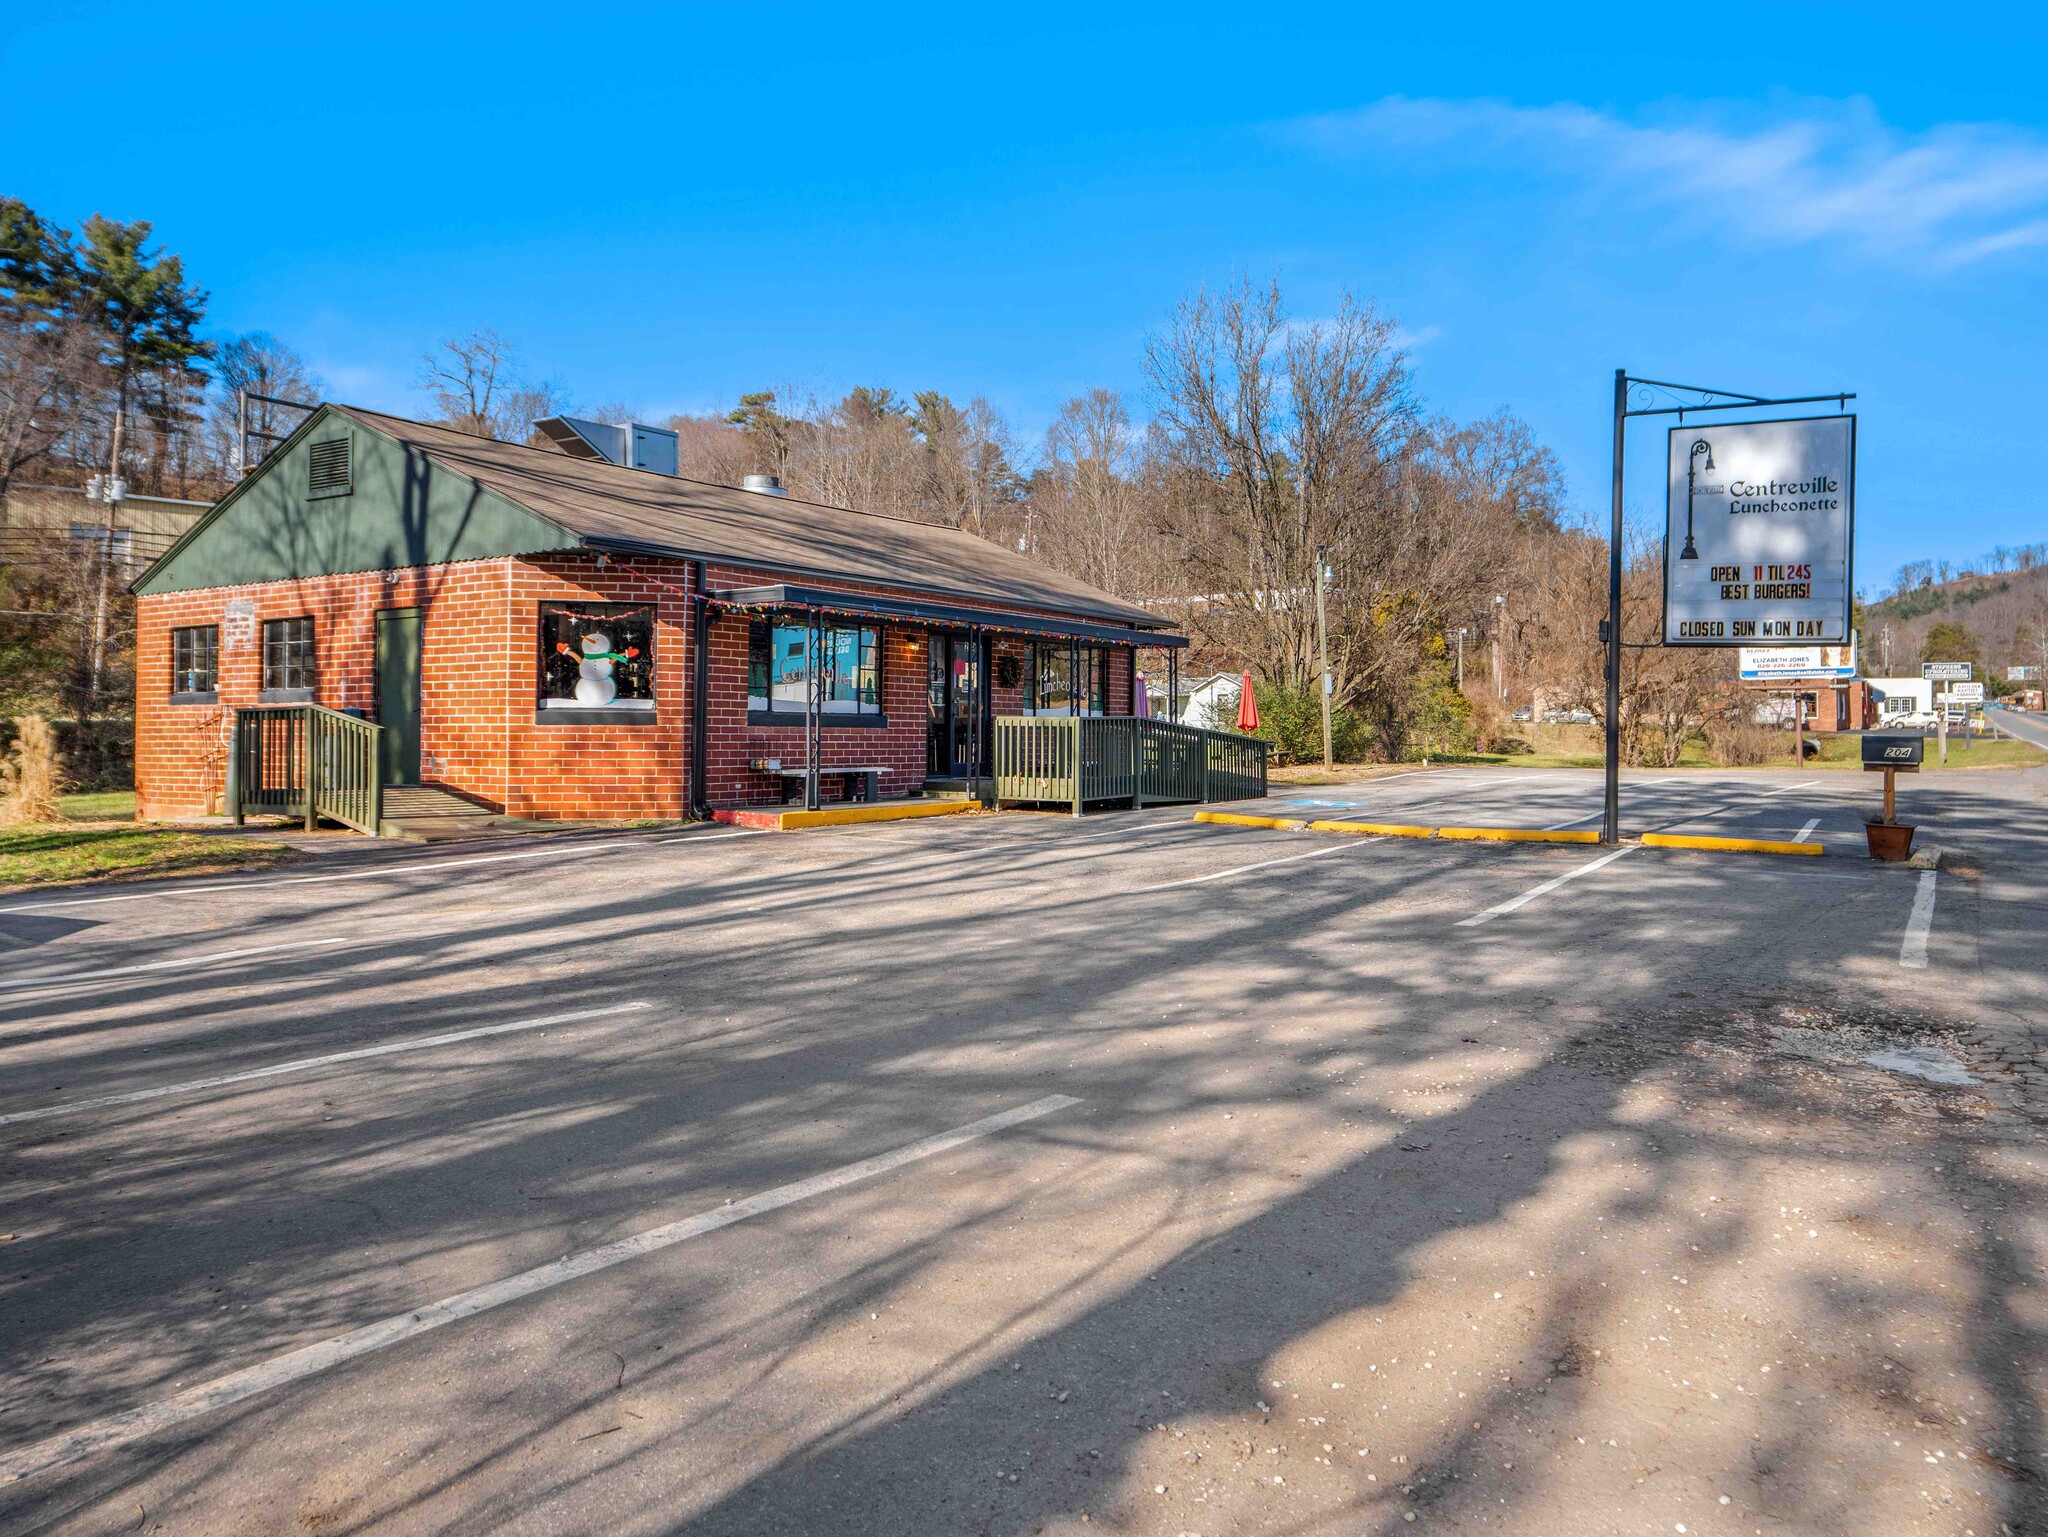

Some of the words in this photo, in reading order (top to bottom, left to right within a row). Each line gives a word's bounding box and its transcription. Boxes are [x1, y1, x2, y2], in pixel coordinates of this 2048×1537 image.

[1730, 475, 1838, 497] Centreville
[1730, 499, 1838, 514] Luncheonette
[1710, 566, 1741, 582] OPEN
[1753, 565, 1763, 581] 11
[1768, 565, 1785, 581] TIL
[1787, 564, 1811, 580] 245
[1721, 584, 1749, 600] BEST
[1754, 583, 1811, 599] BURGERS!
[1680, 621, 1724, 637] CLOSED
[1732, 621, 1756, 637] SUN
[1886, 748, 1910, 757] 204
